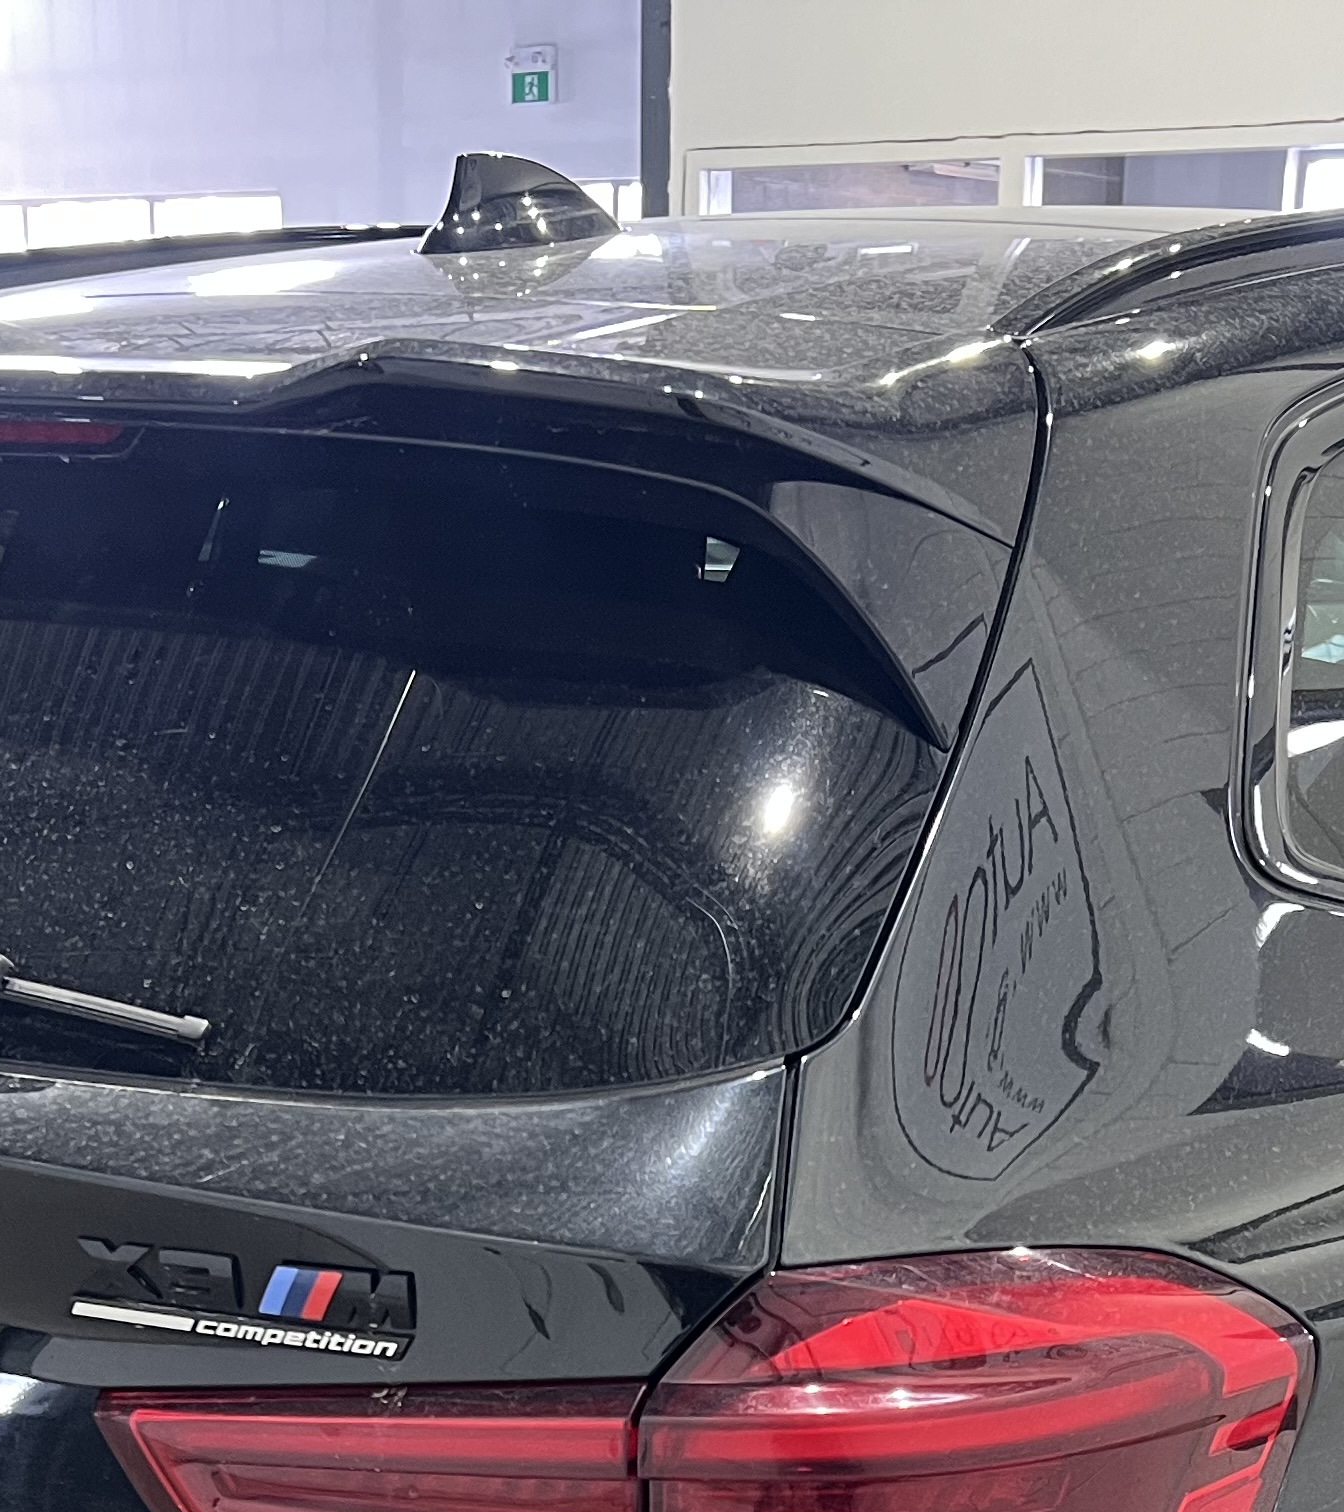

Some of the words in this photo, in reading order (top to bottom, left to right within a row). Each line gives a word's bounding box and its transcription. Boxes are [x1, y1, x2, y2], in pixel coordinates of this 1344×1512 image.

[71, 1235, 245, 1309] X3
[316, 1259, 418, 1335] M
[194, 1319, 399, 1358] competition
